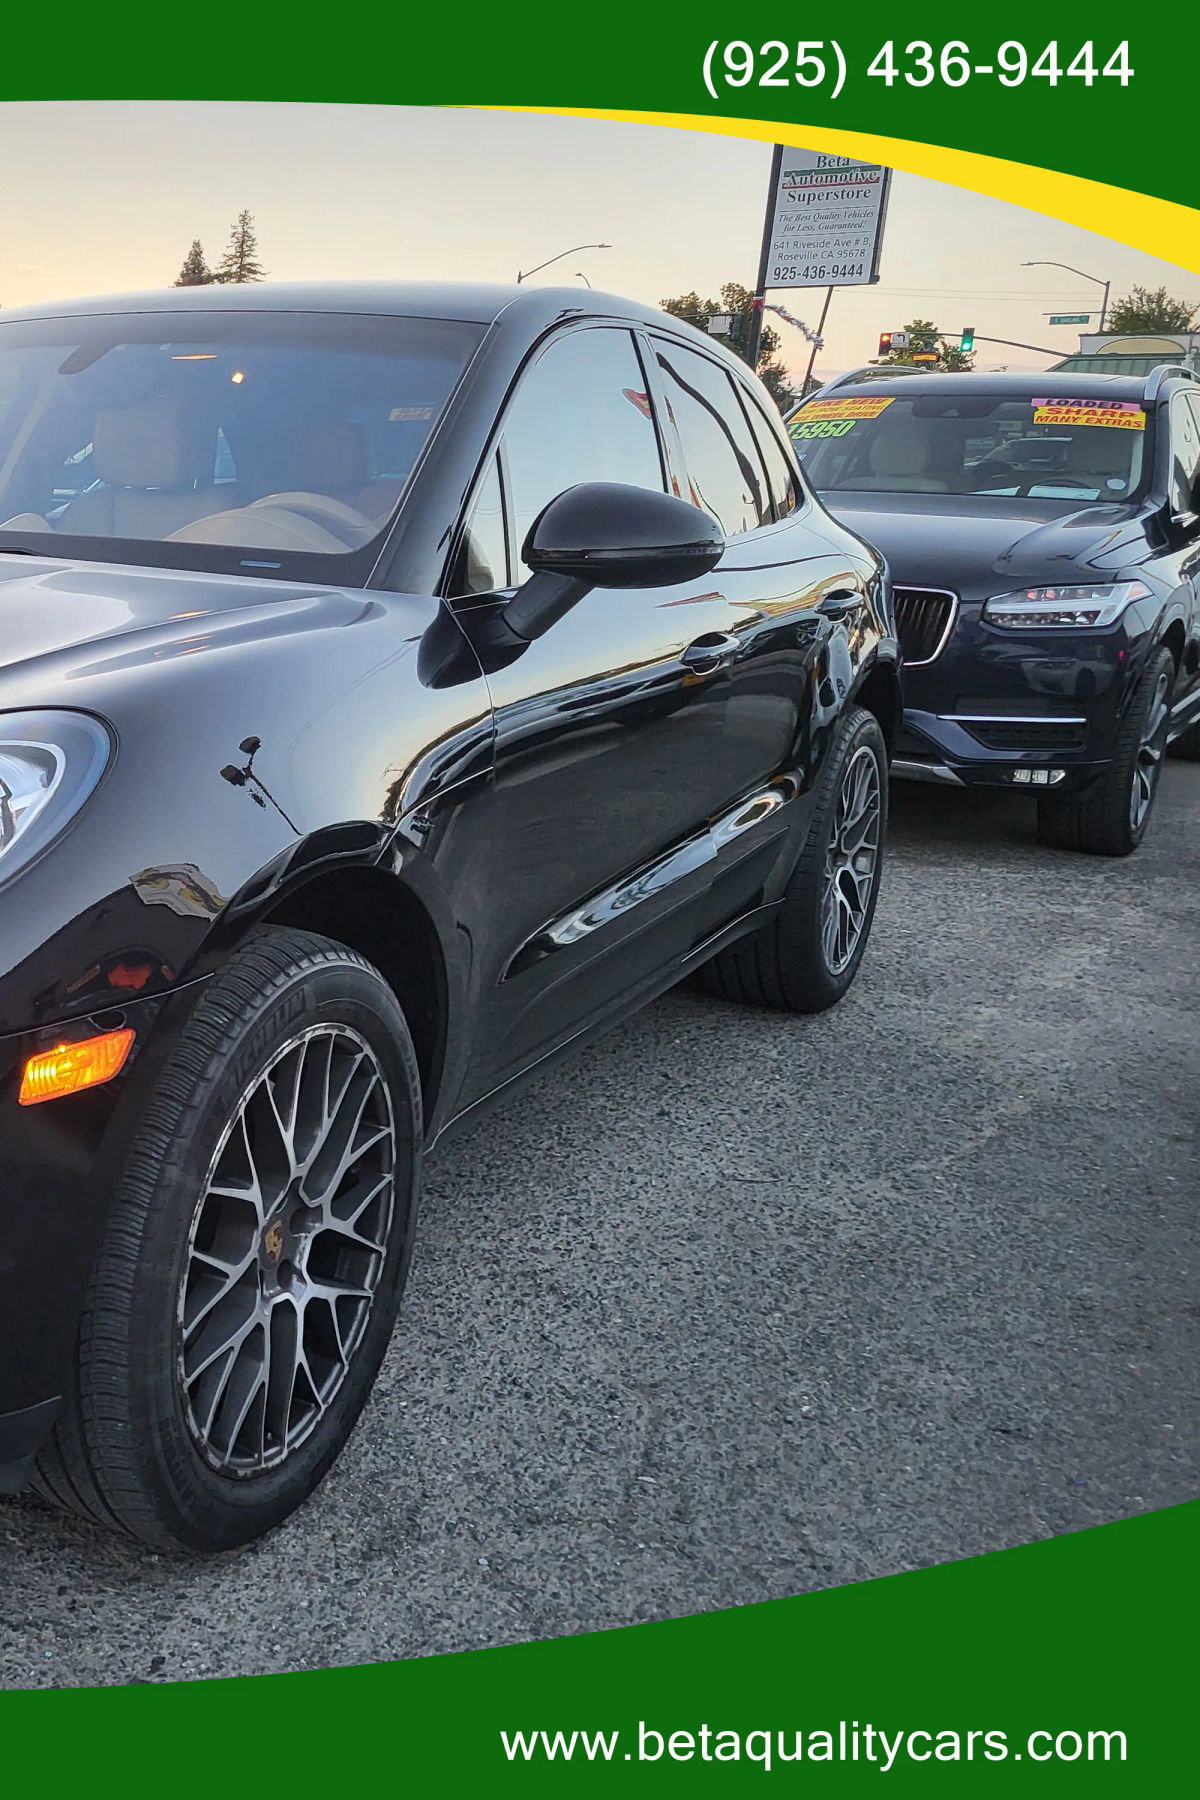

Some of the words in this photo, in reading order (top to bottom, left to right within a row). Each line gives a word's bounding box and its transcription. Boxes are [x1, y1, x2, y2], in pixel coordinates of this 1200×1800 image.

[816, 155, 850, 168] Beta
[788, 168, 877, 187] Automotive
[786, 188, 872, 205] Superstore
[778, 213, 794, 223] The
[794, 213, 811, 222] Best
[782, 224, 796, 235] for
[773, 241, 790, 250] 641
[833, 238, 852, 247] Ave
[777, 251, 818, 261] Roseville
[821, 250, 834, 259] CA
[837, 248, 866, 259] 95678
[773, 263, 864, 281] 925-436-9444
[1045, 399, 1124, 410] LOADED
[1046, 407, 1136, 418] SHARP
[1035, 415, 1080, 424] MANY
[1084, 417, 1142, 428] EXTRAS
